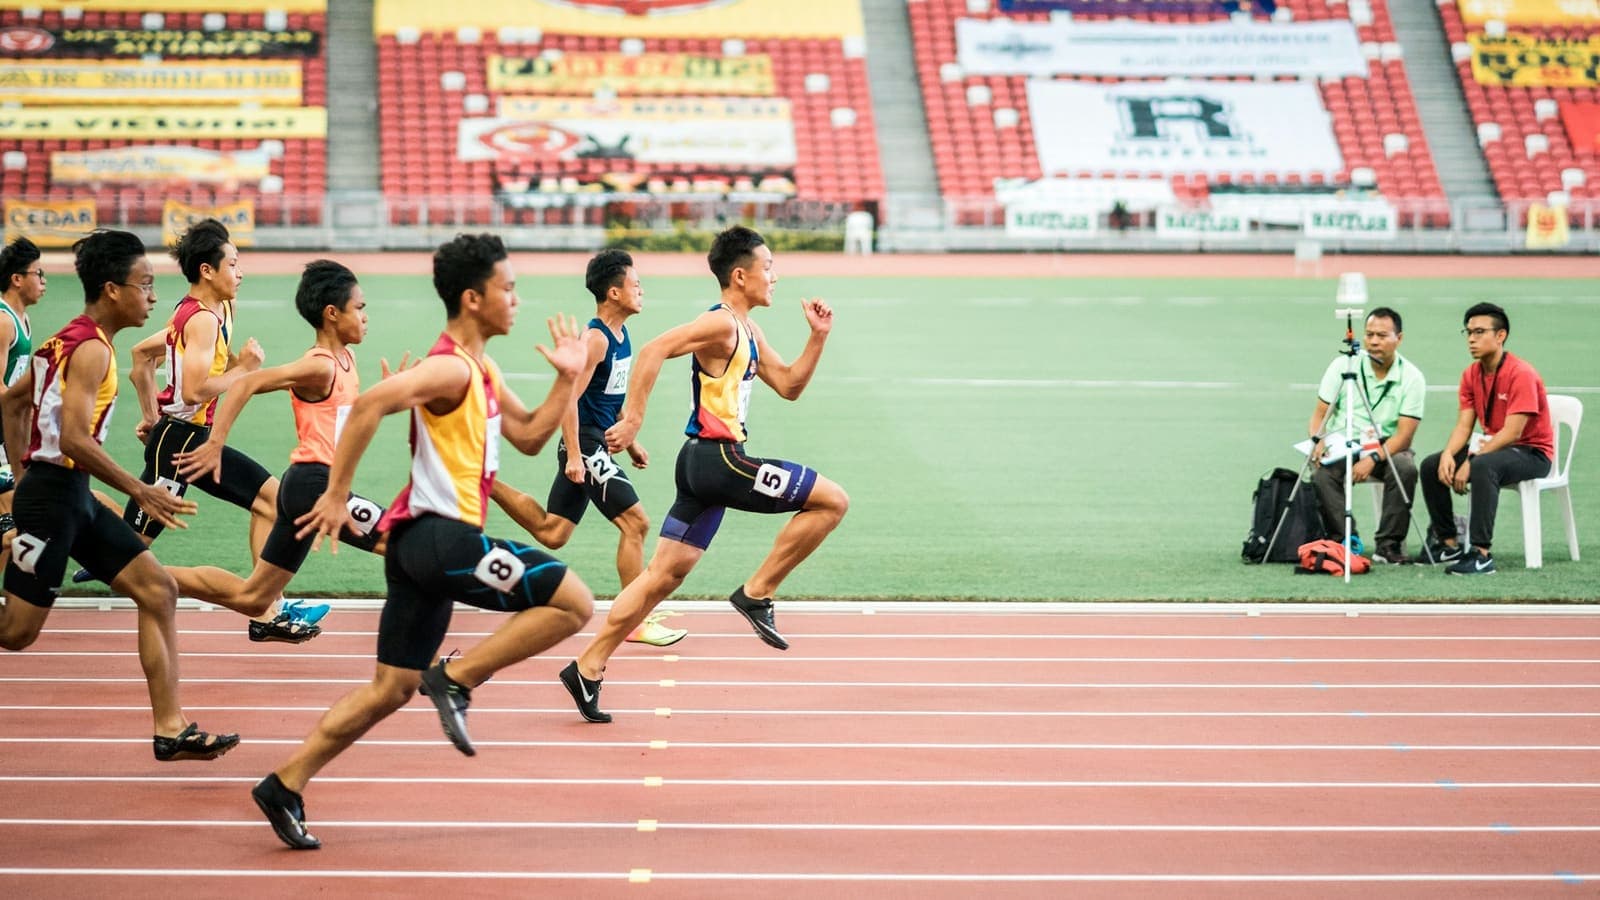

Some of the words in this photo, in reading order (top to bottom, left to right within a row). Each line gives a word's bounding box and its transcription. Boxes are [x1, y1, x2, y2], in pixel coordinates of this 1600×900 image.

[8, 208, 93, 227] CEDAR
[593, 458, 611, 477] 2
[762, 471, 781, 490] 5
[351, 504, 372, 523] 6
[18, 540, 35, 562] 7
[488, 558, 513, 581] 8
